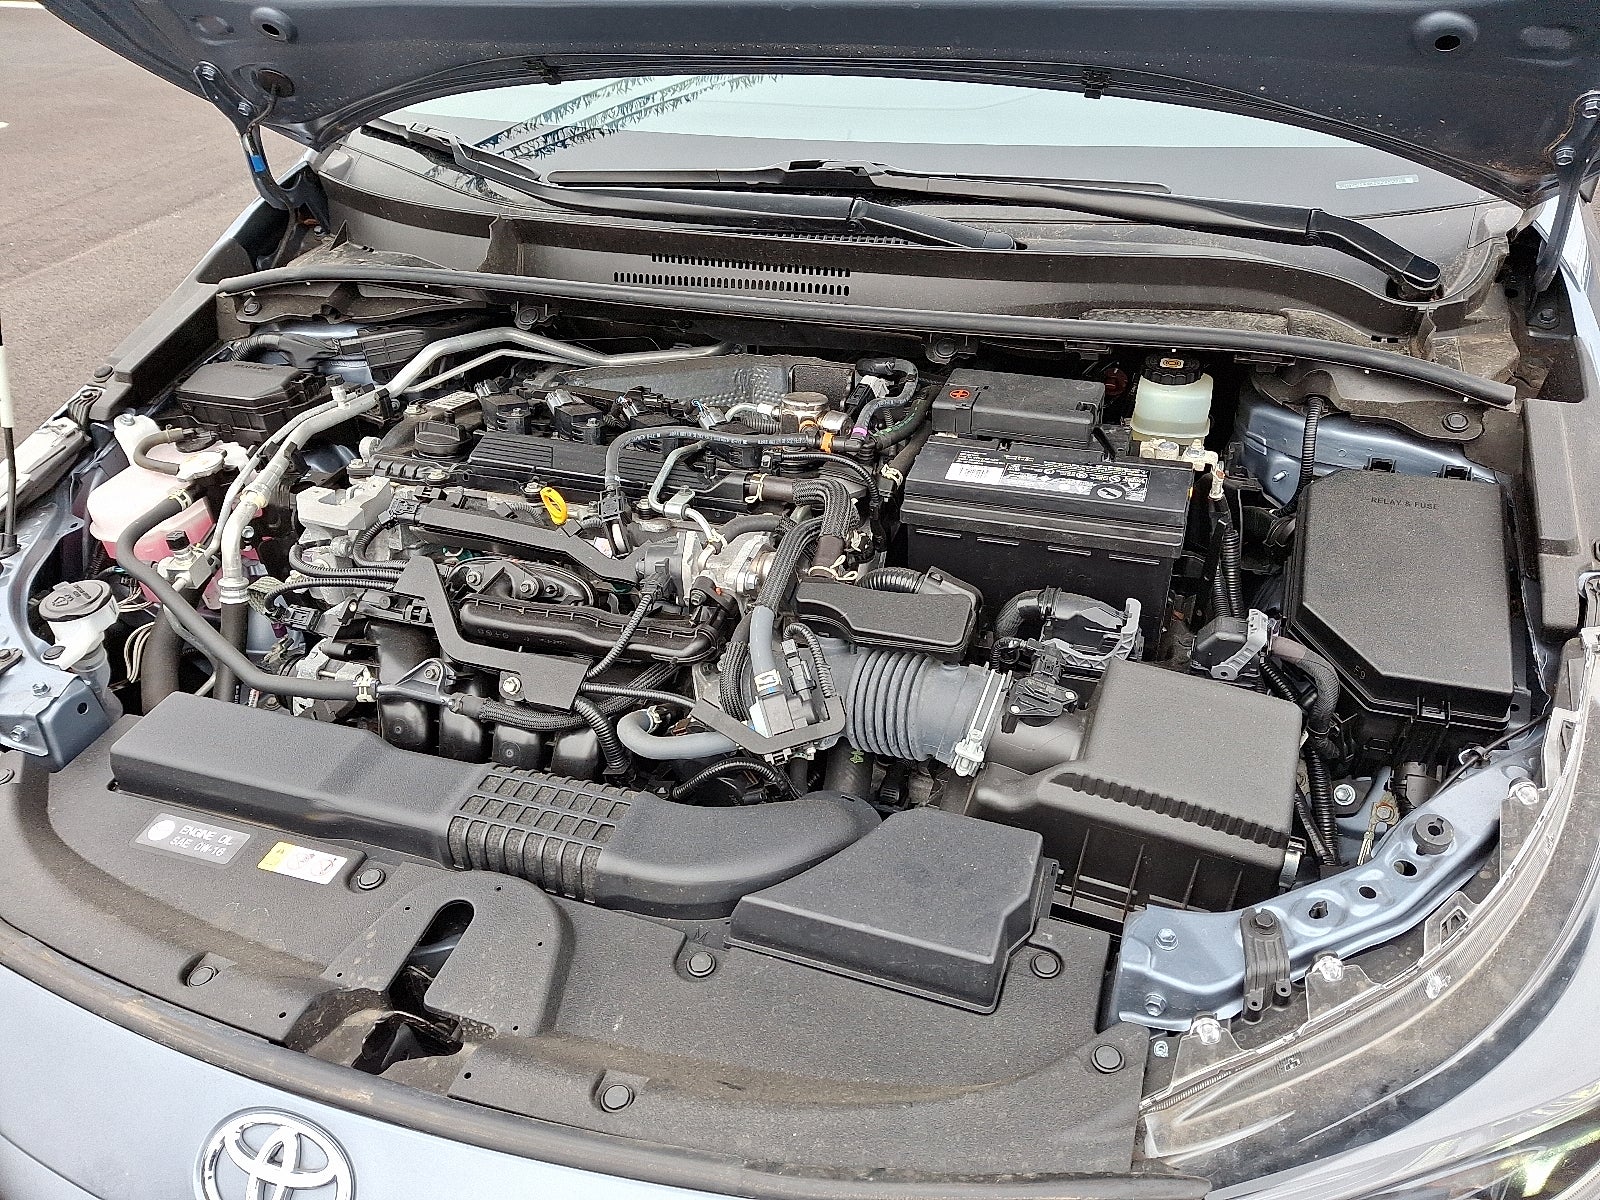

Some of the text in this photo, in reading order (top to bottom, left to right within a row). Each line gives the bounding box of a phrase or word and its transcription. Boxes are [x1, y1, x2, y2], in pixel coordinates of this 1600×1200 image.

[1371, 496, 1401, 506] RELAY
[1414, 501, 1439, 510] FUSE
[178, 824, 233, 846] ENGINE OIL
[169, 836, 227, 857] SAE 0W-16
